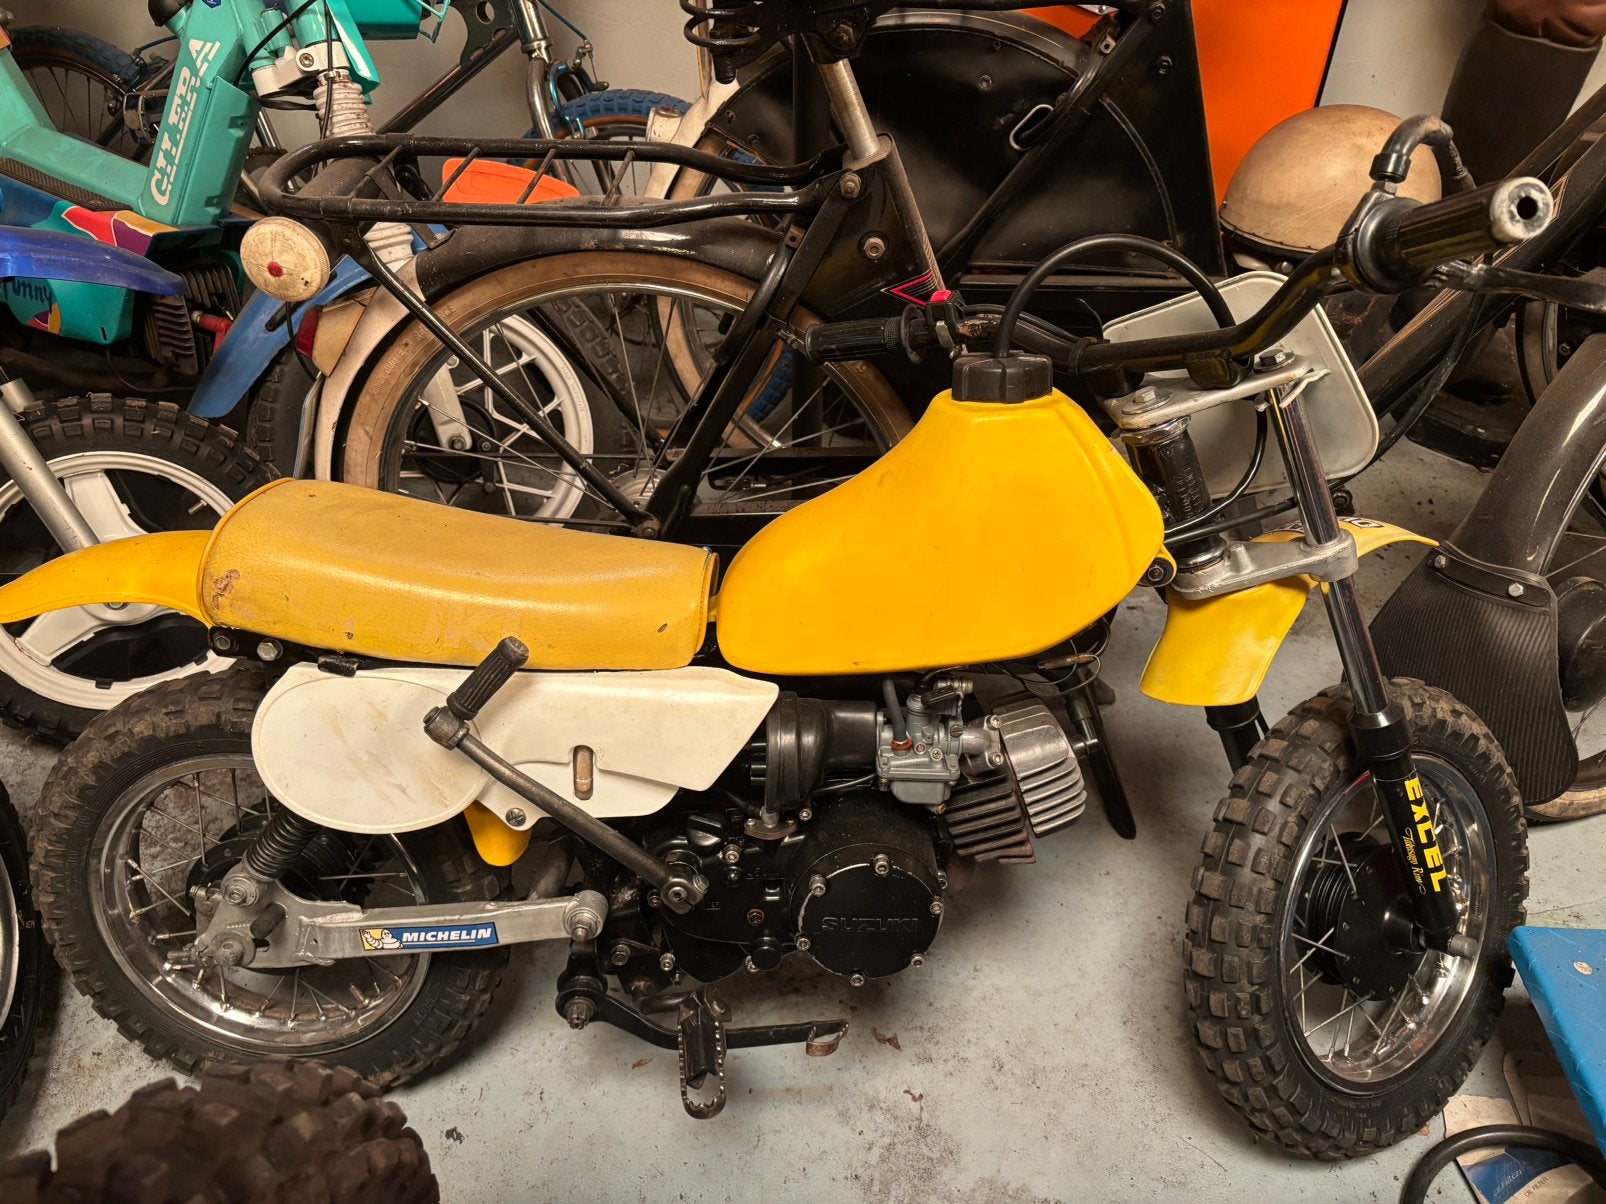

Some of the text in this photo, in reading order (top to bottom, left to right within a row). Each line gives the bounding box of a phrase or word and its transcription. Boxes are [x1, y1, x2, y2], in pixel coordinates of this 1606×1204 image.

[150, 38, 221, 206] GILERA
[1404, 776, 1447, 893] EXCEL
[402, 927, 492, 943] MICHELIN
[821, 916, 919, 933] SUZUKI
